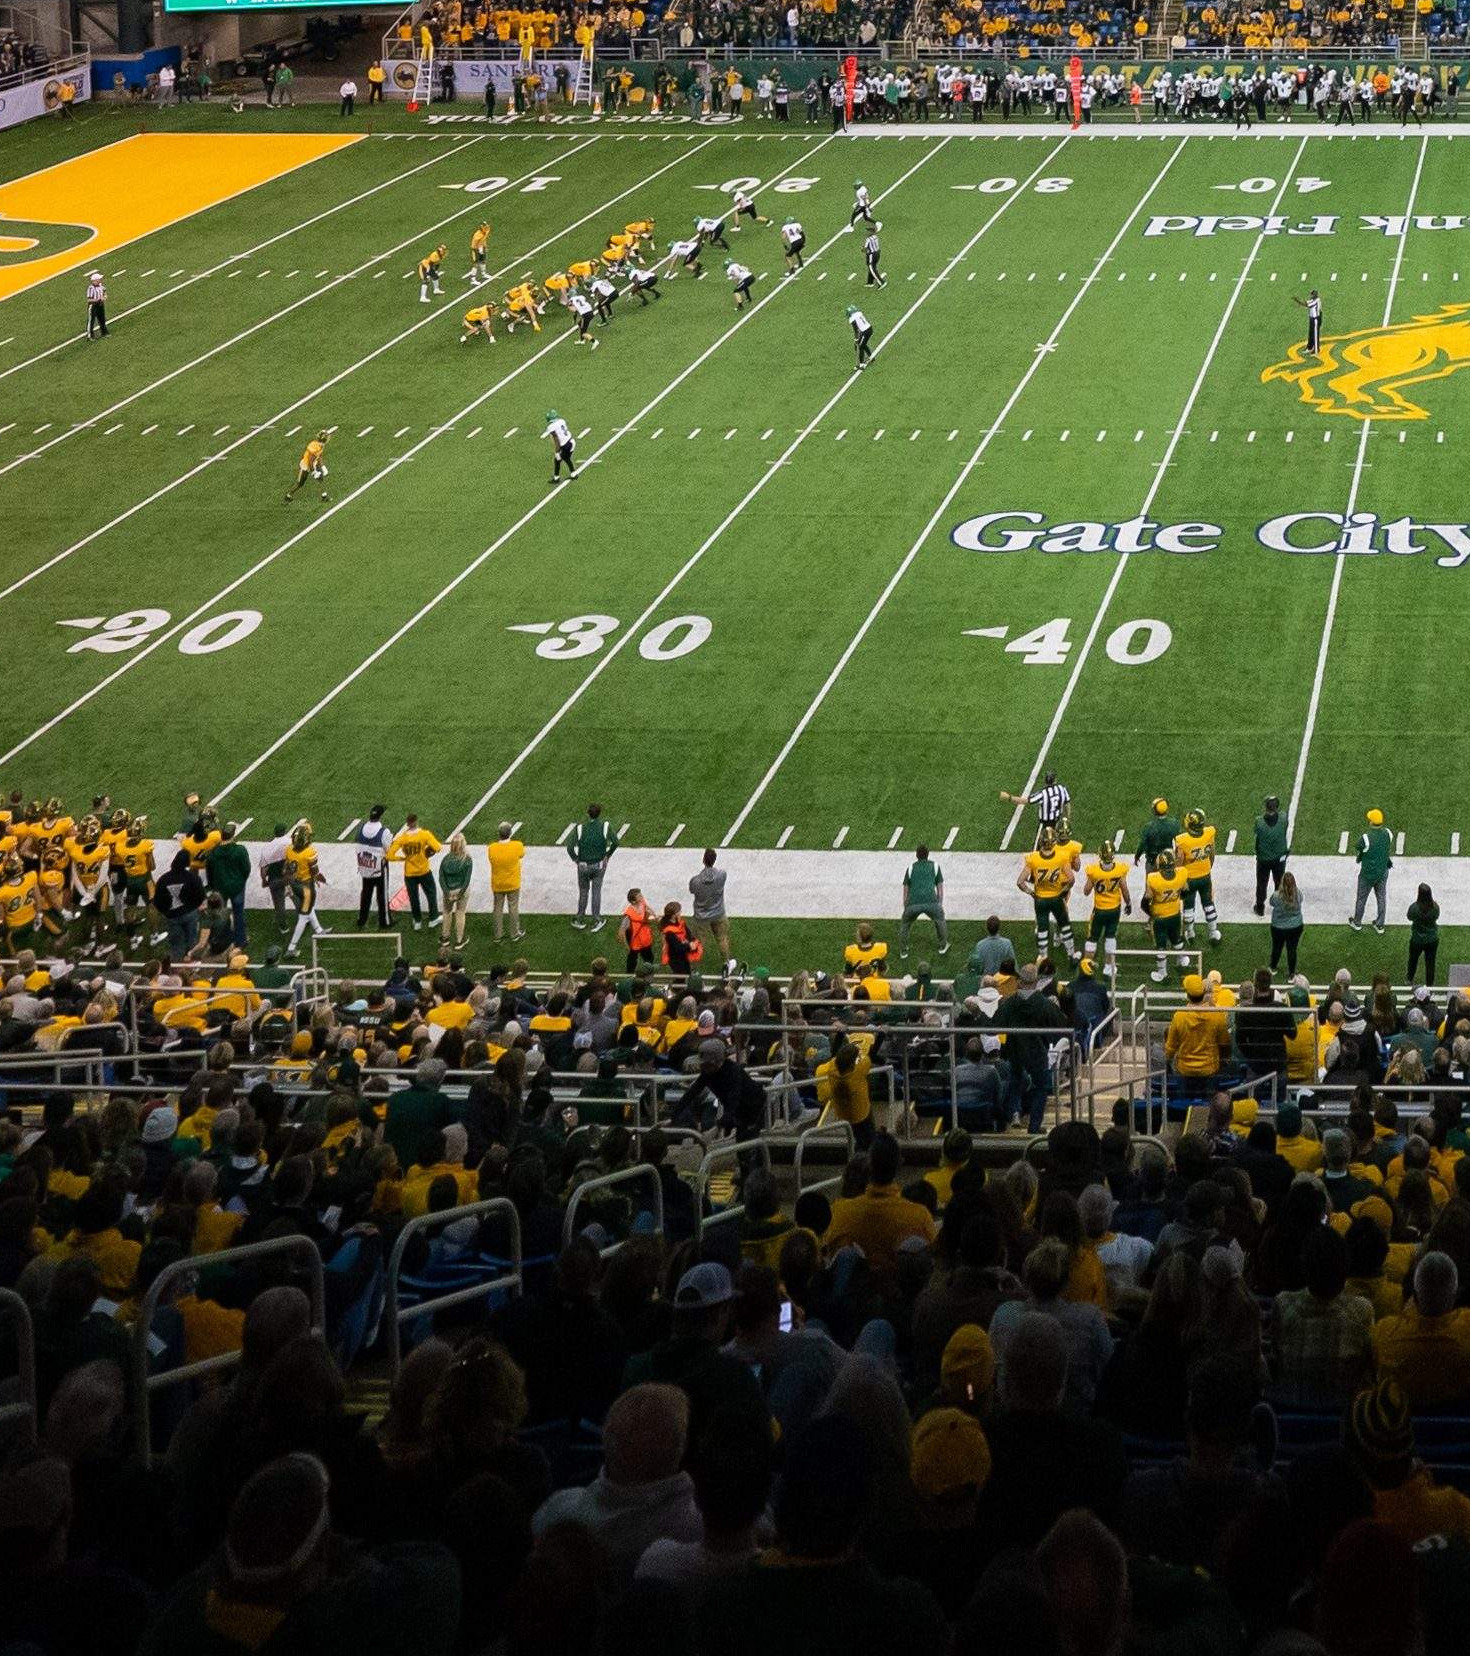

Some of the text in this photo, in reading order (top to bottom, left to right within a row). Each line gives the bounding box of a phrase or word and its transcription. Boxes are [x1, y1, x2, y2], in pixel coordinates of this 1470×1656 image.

[1144, 213, 1338, 237] Field
[948, 509, 1224, 558] Gate
[65, 607, 263, 656] 20
[532, 612, 713, 662] 30
[1002, 617, 1173, 667] 40
[1035, 868, 1061, 884] 76
[1094, 877, 1121, 894] 67
